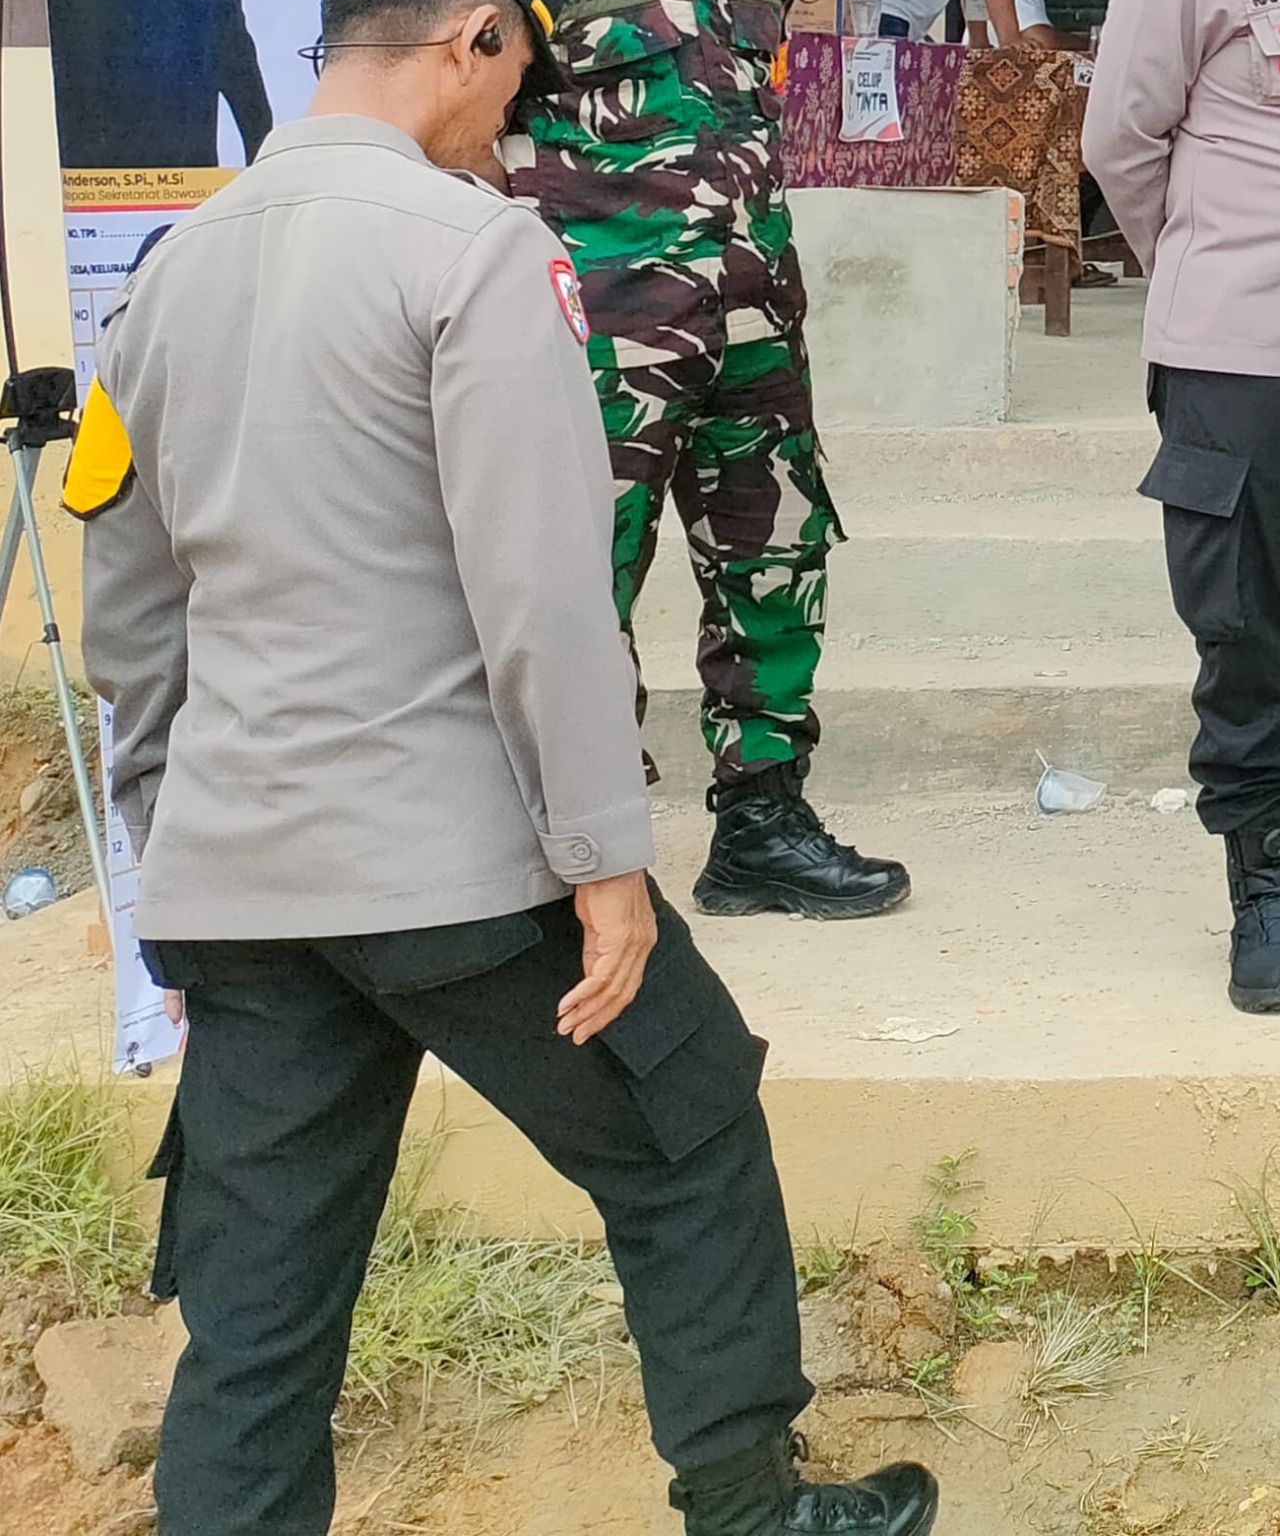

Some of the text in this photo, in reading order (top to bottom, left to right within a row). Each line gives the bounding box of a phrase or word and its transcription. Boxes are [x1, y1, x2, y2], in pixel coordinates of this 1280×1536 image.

[858, 72, 882, 88] CELUP
[856, 92, 889, 113] TINTA
[157, 172, 184, 186] M.Si
[100, 188, 160, 200] Sekretariat
[164, 187, 211, 200] Bawaslu
[74, 310, 90, 322] NO
[104, 714, 112, 726] 9
[112, 841, 123, 854] 12
